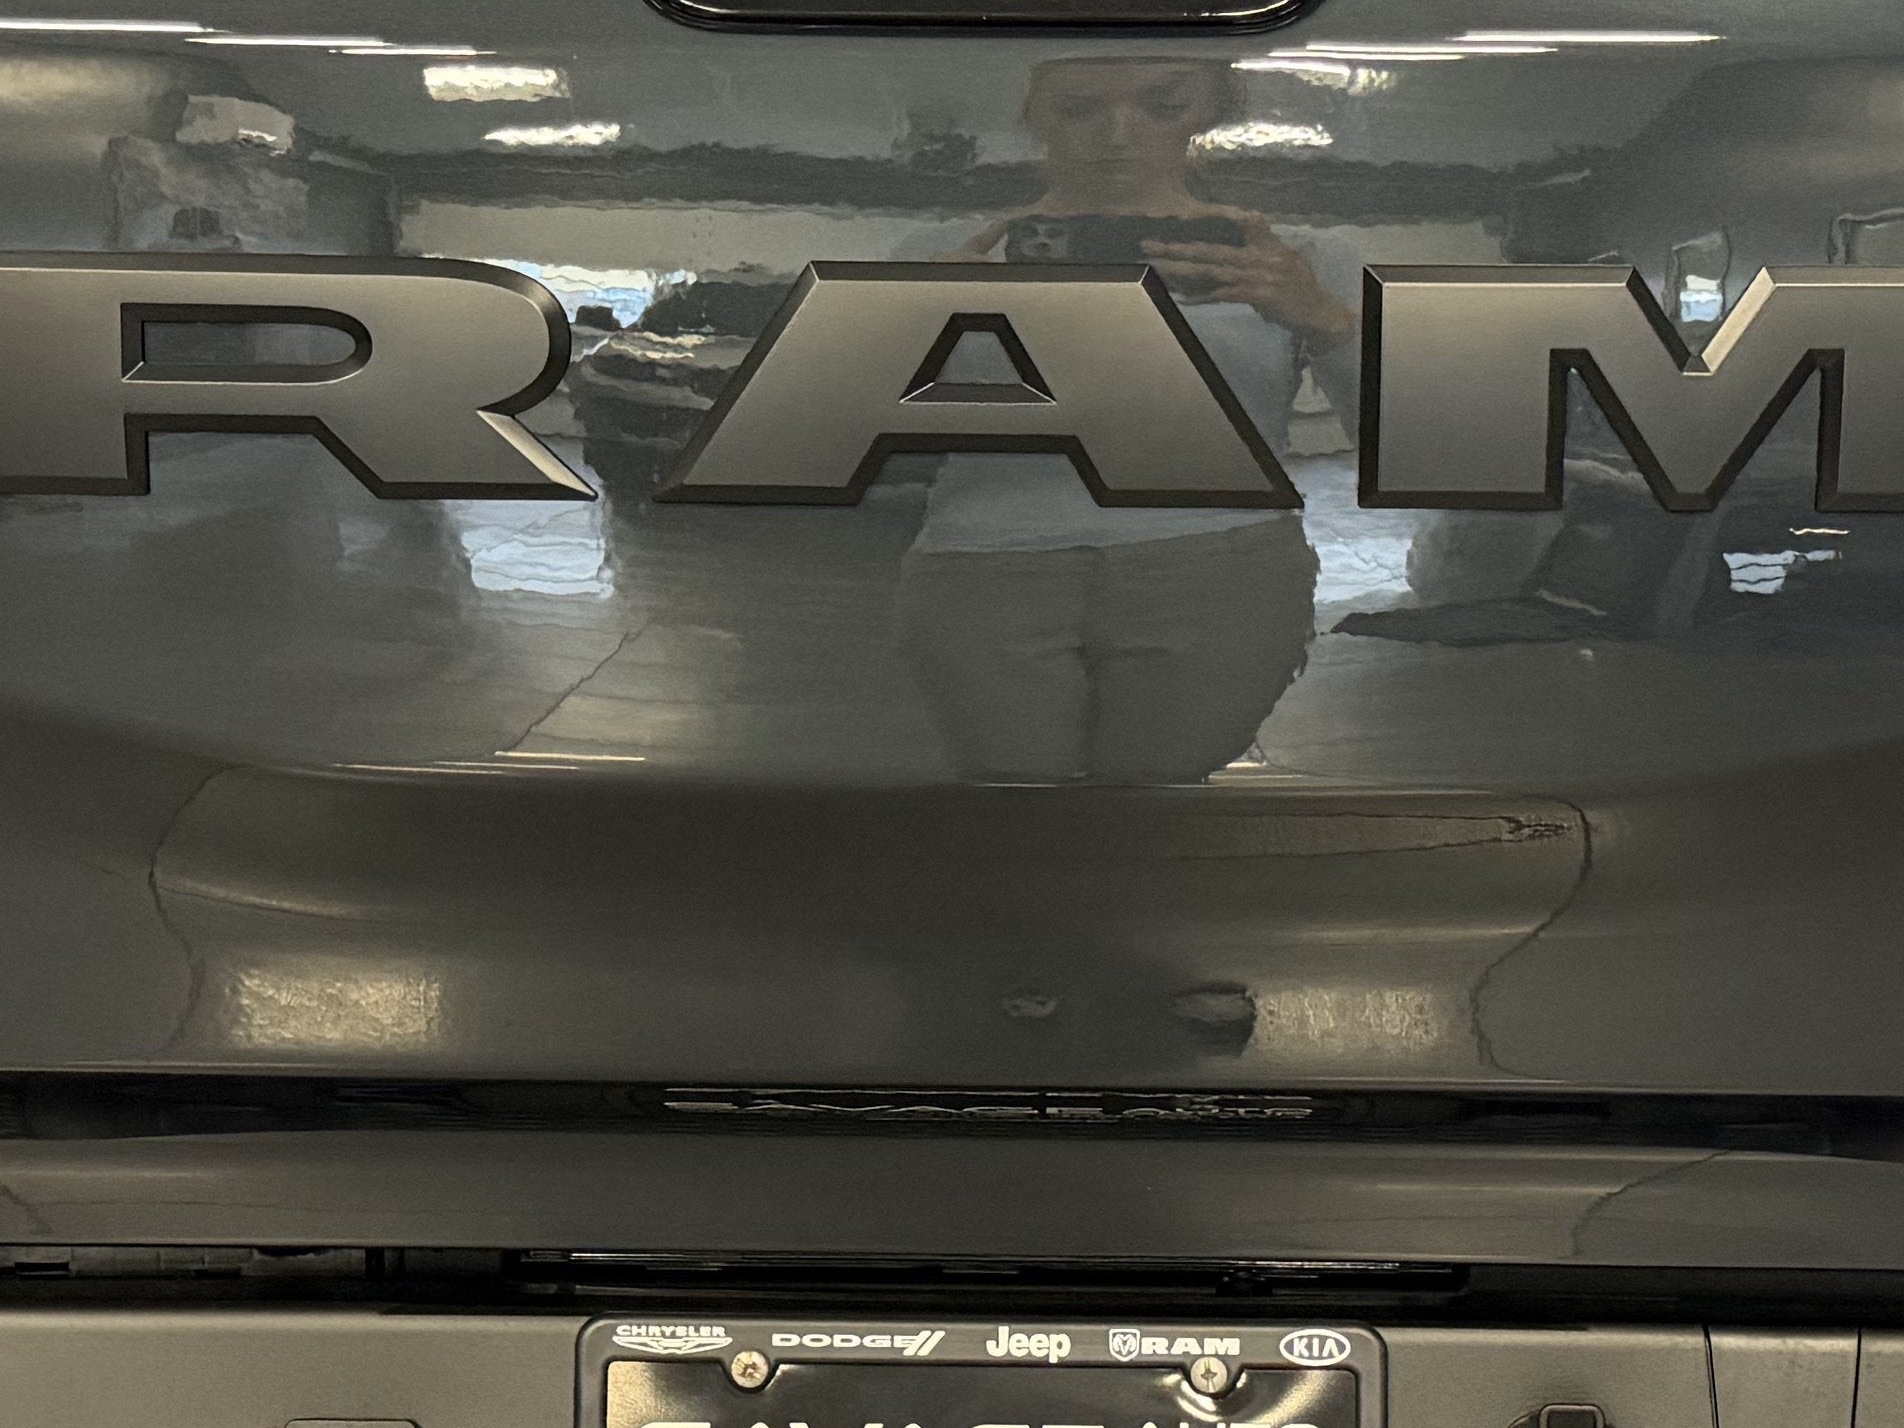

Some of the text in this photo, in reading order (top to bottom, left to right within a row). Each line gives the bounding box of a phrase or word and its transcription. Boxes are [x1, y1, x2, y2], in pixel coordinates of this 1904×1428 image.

[615, 1324, 727, 1339] CHRYSLER
[771, 1332, 927, 1349] DODGE
[986, 1325, 1072, 1363] Jeep
[1140, 1336, 1241, 1356] RAM
